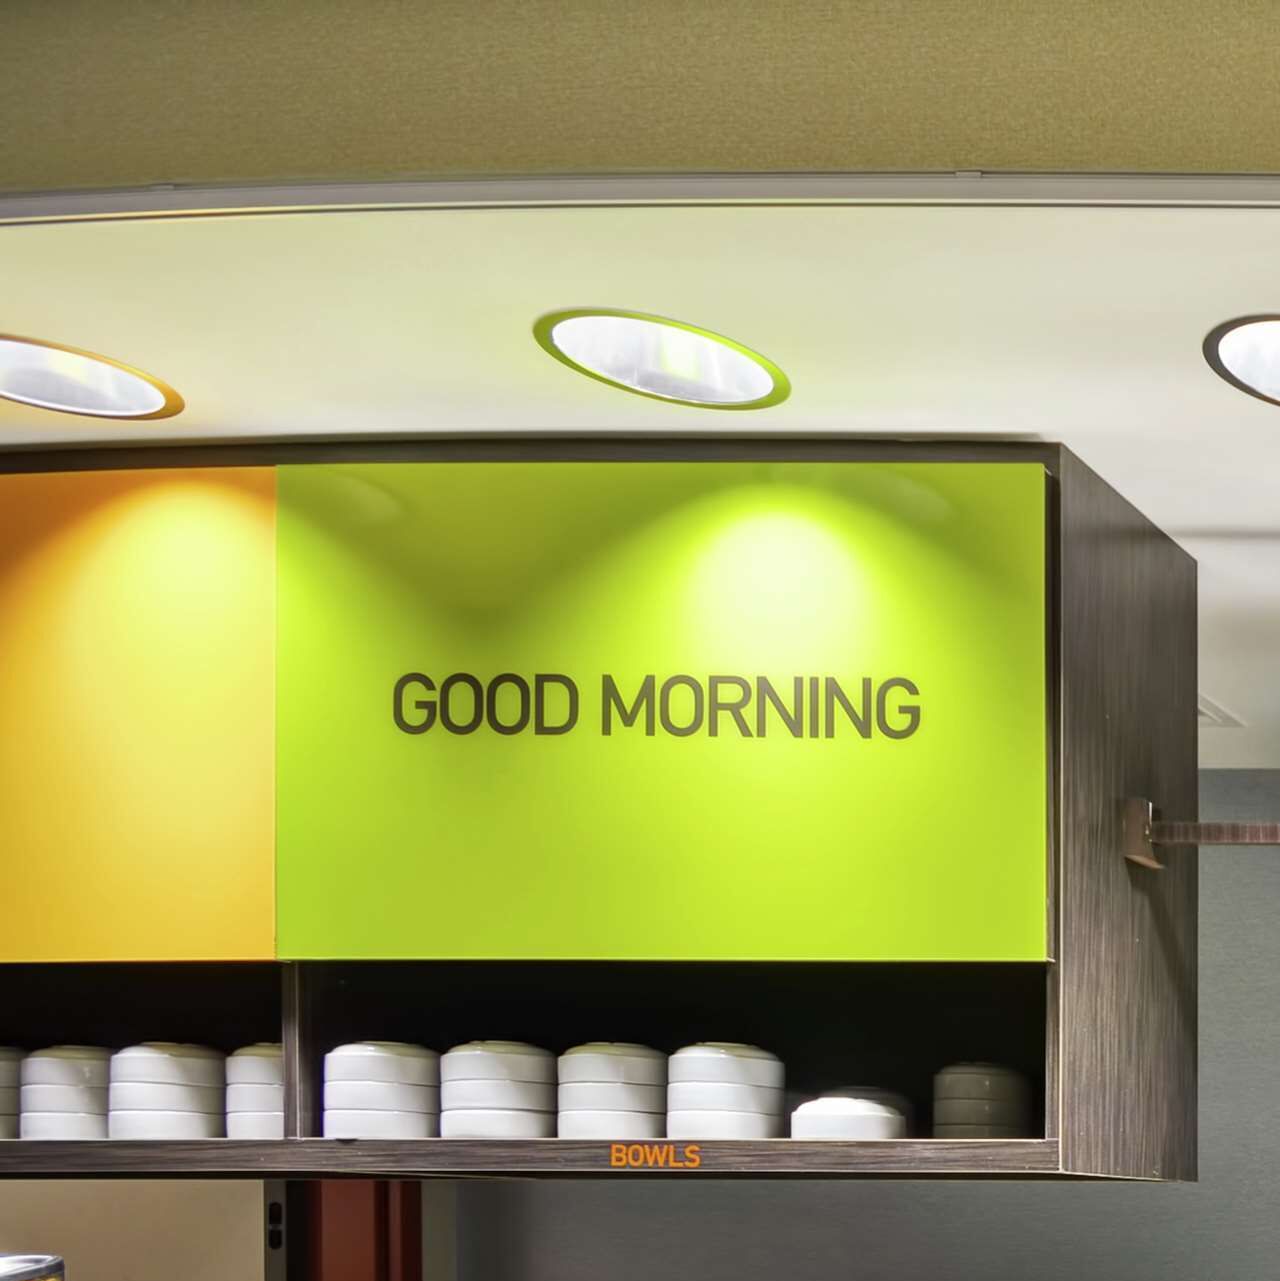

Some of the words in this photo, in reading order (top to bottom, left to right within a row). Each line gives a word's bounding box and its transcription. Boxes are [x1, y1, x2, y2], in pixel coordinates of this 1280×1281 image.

[393, 672, 579, 736] GOOD
[601, 674, 921, 740] MORNING
[610, 1143, 701, 1167] BOWLS
